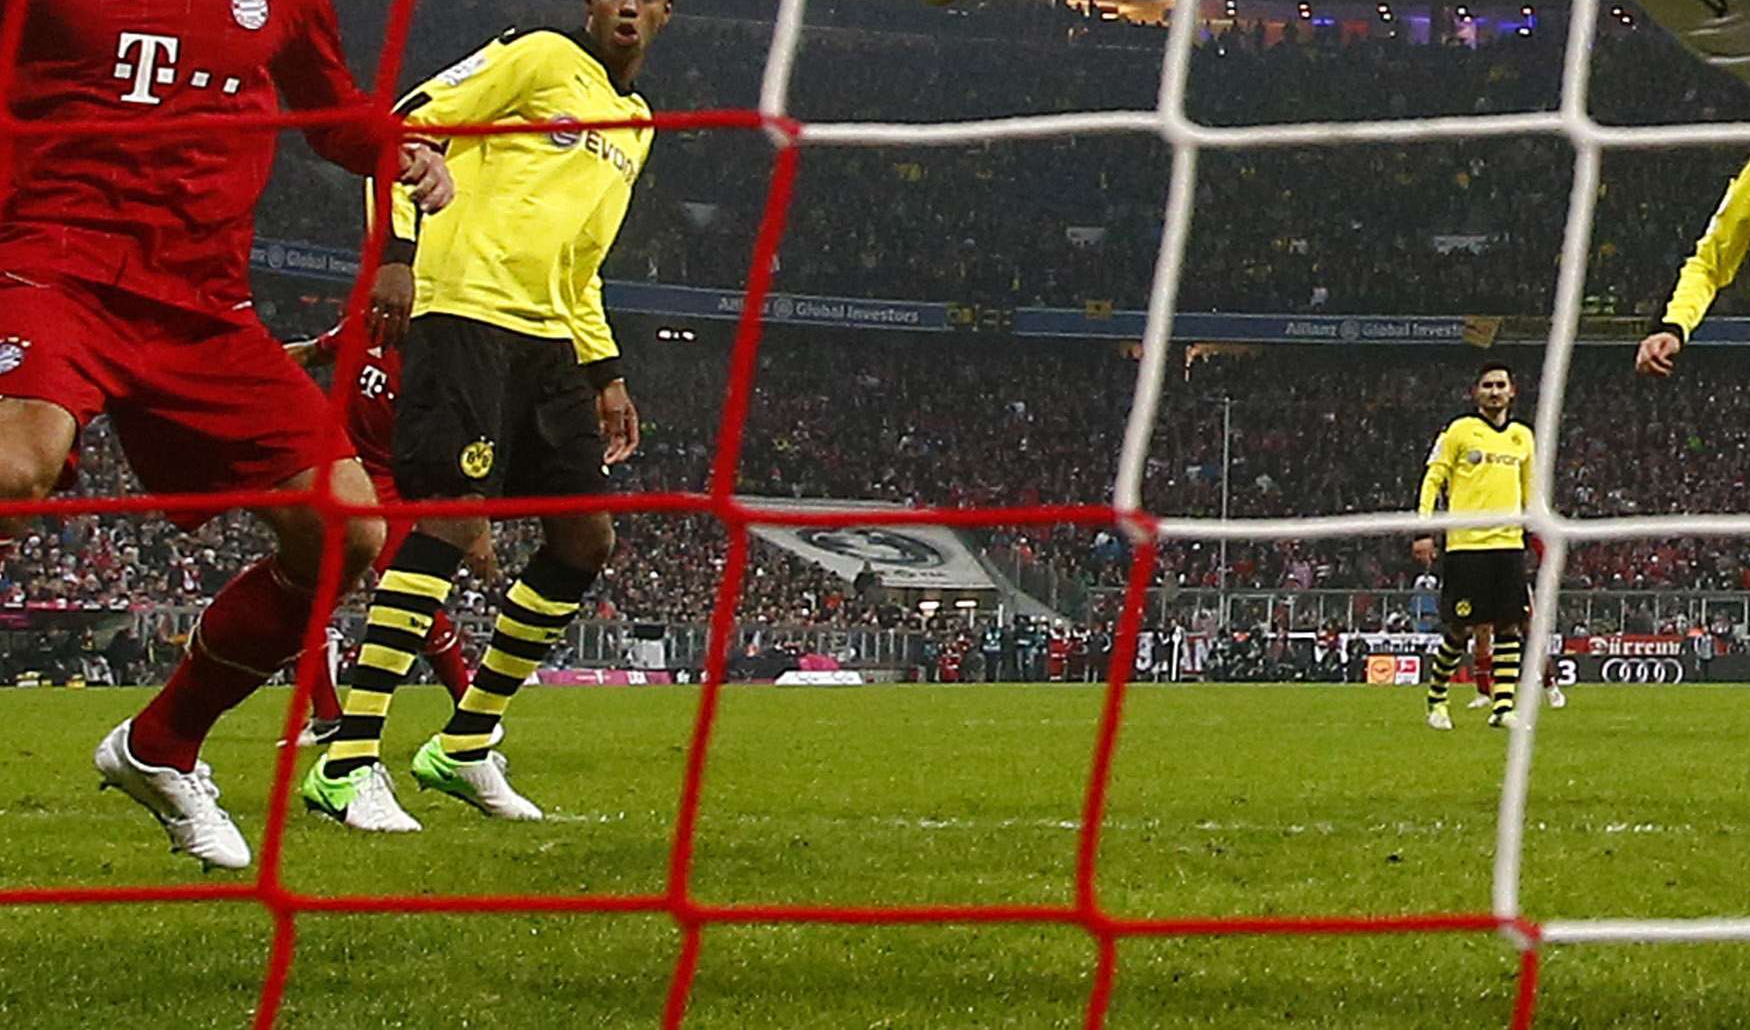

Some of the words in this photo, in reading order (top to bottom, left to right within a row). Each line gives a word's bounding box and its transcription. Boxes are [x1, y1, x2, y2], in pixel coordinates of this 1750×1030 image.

[796, 301, 845, 319] Global
[847, 305, 919, 323] Investors
[1285, 321, 1337, 337] Allianz
[1361, 322, 1410, 338] Global
[1413, 322, 1465, 338] Invest
